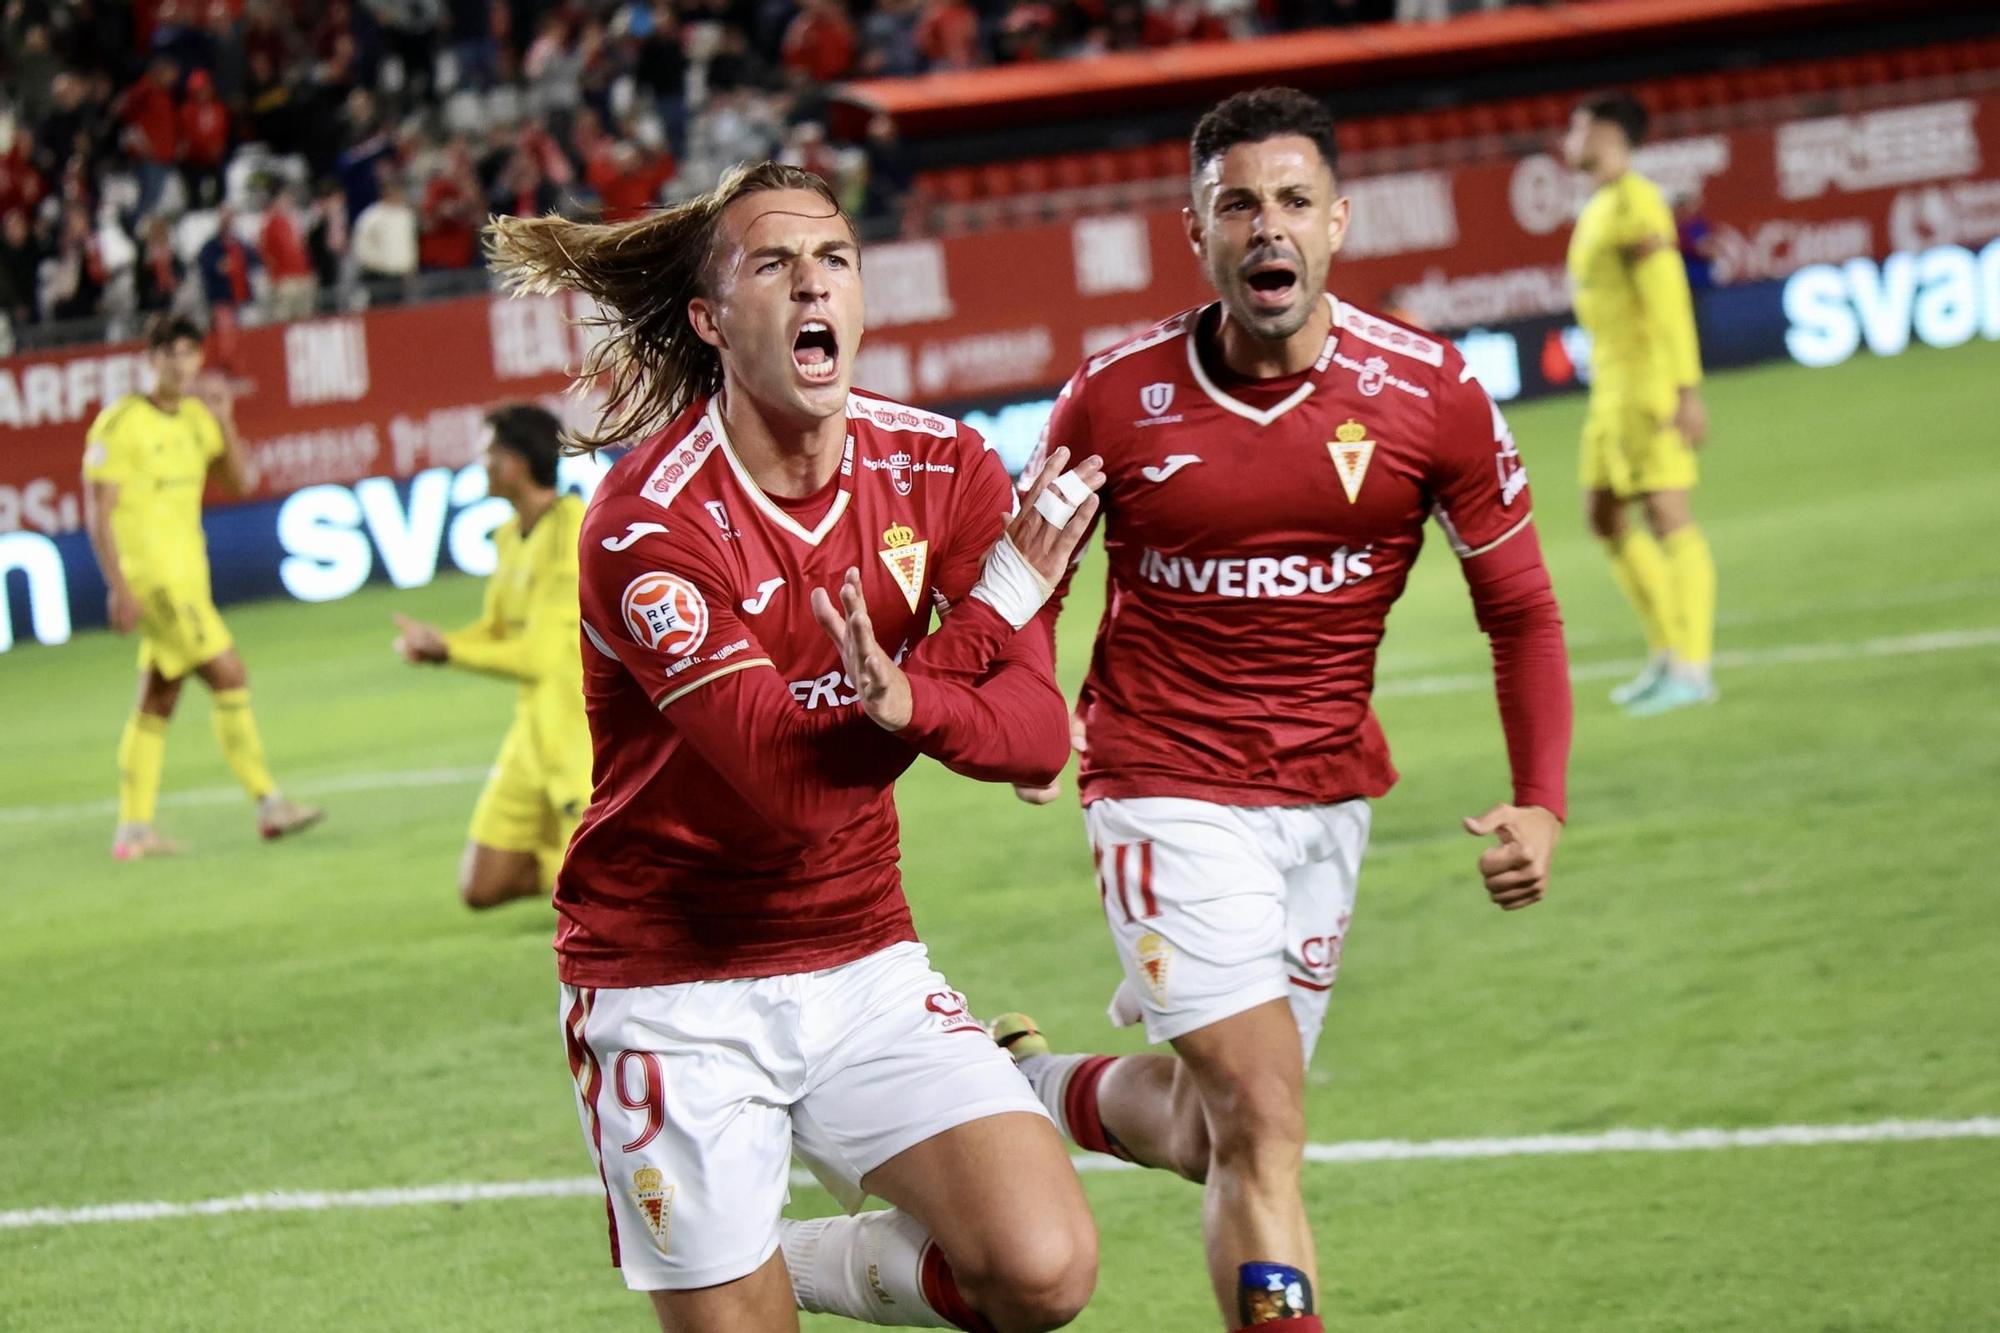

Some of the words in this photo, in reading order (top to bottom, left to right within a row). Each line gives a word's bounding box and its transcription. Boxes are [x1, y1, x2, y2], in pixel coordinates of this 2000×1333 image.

[1781, 236, 2000, 368] sva
[1112, 839, 1164, 925] 11
[613, 1048, 665, 1153] 9
